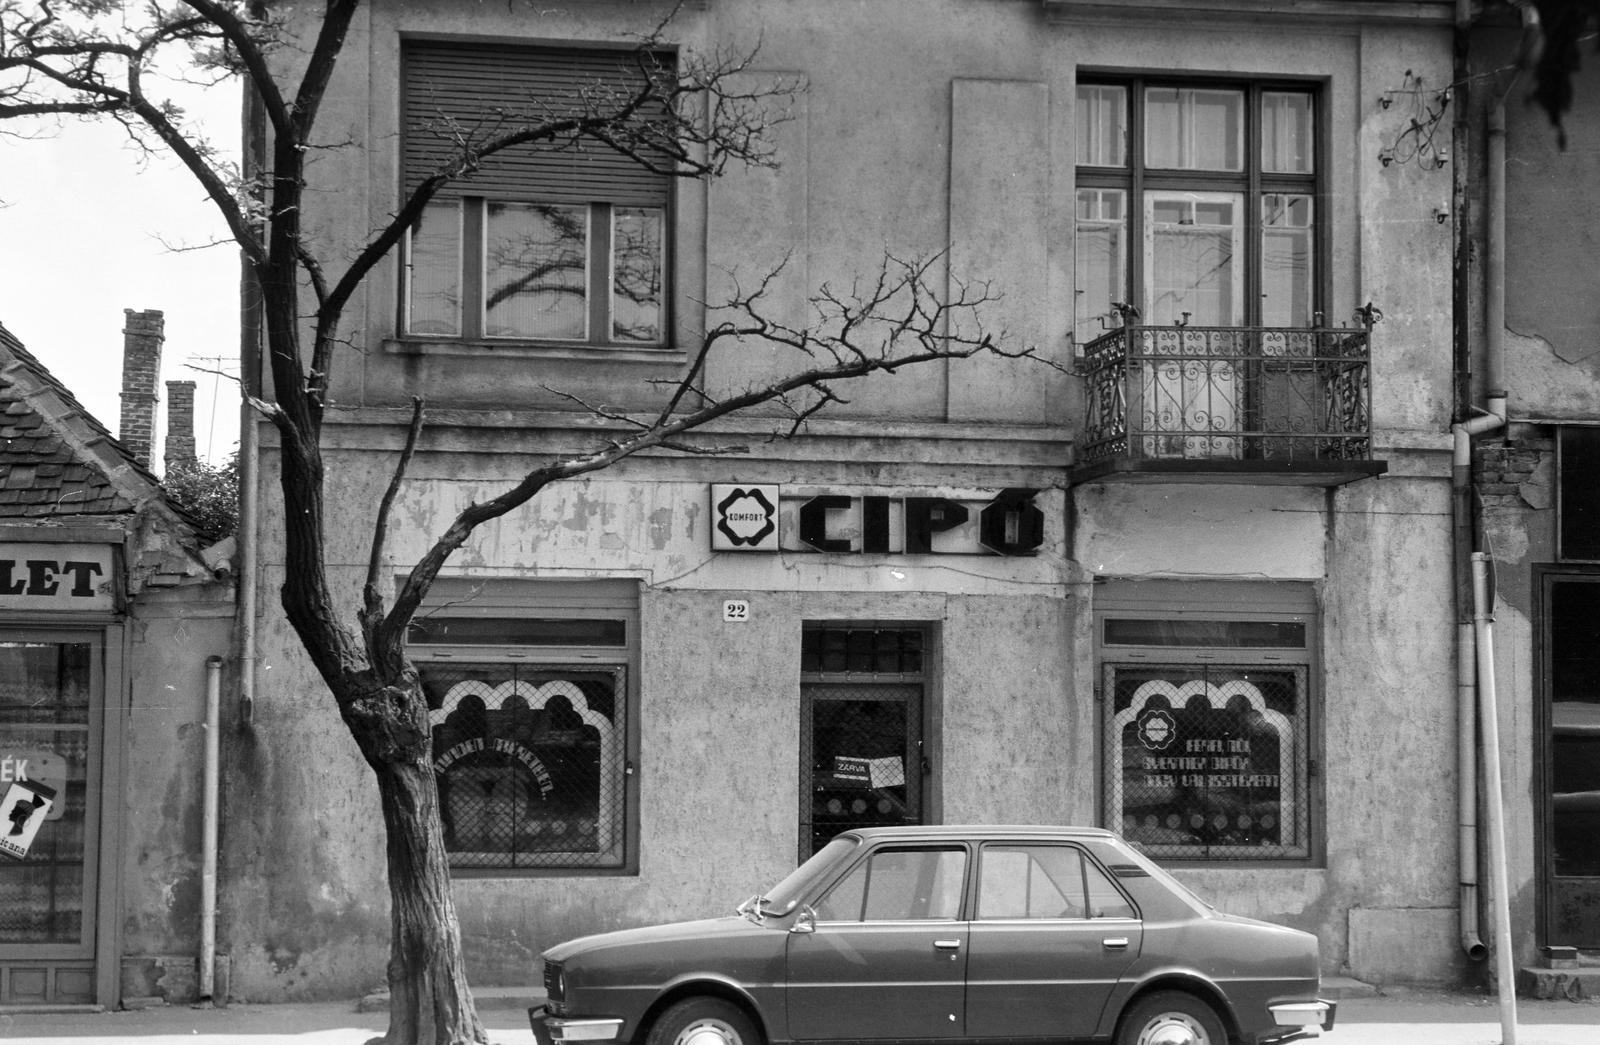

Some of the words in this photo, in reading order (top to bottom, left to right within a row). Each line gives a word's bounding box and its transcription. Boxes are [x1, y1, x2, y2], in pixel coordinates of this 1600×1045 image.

[729, 513, 763, 521] KOMFORT
[0, 560, 103, 597] LET
[727, 604, 746, 618] 22
